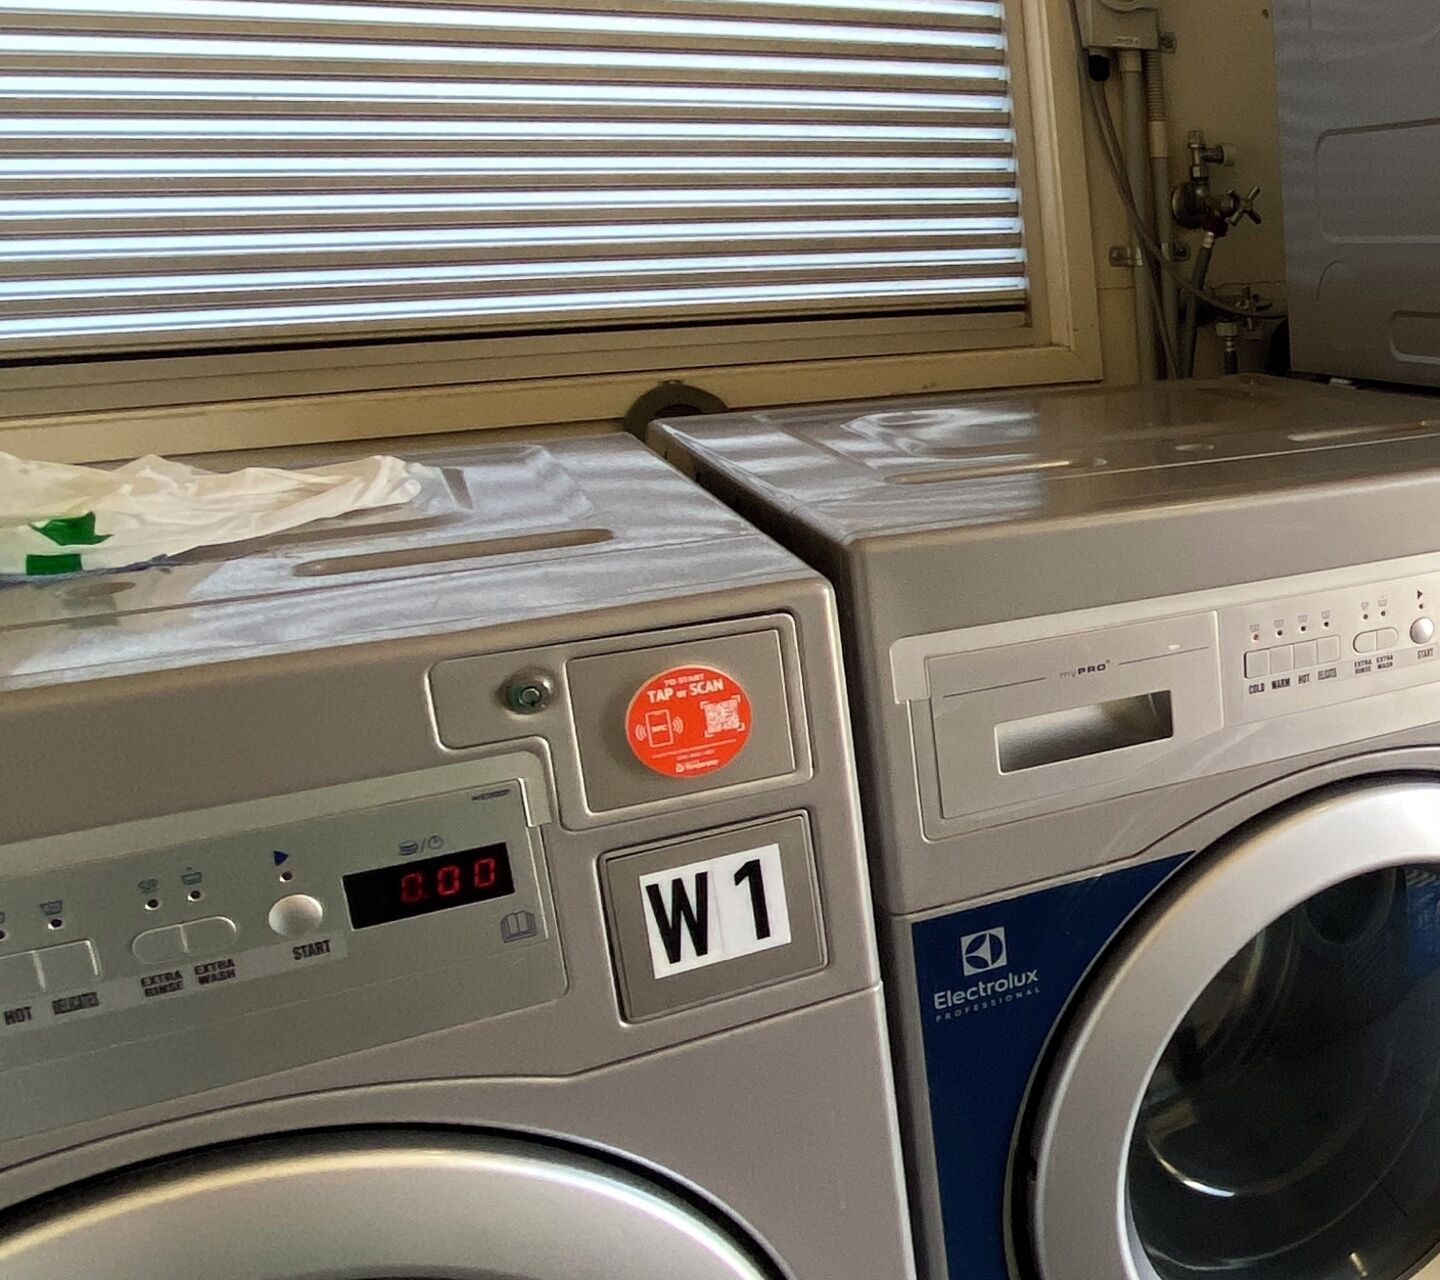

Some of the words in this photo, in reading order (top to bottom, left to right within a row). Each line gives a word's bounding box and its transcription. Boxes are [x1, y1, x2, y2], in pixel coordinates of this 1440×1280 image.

[647, 688, 674, 704] TAP
[689, 678, 725, 696] SCAN
[1271, 677, 1291, 690] WARM
[140, 970, 184, 988] EXTRA
[194, 958, 236, 975] EXTRA
[292, 939, 332, 961] START
[144, 981, 184, 997] RINSE
[197, 969, 236, 985] WASH
[933, 969, 1039, 1010] Electrolux
[3, 1006, 33, 1026] HOT
[935, 987, 1040, 1022] PROFESSIONAL
